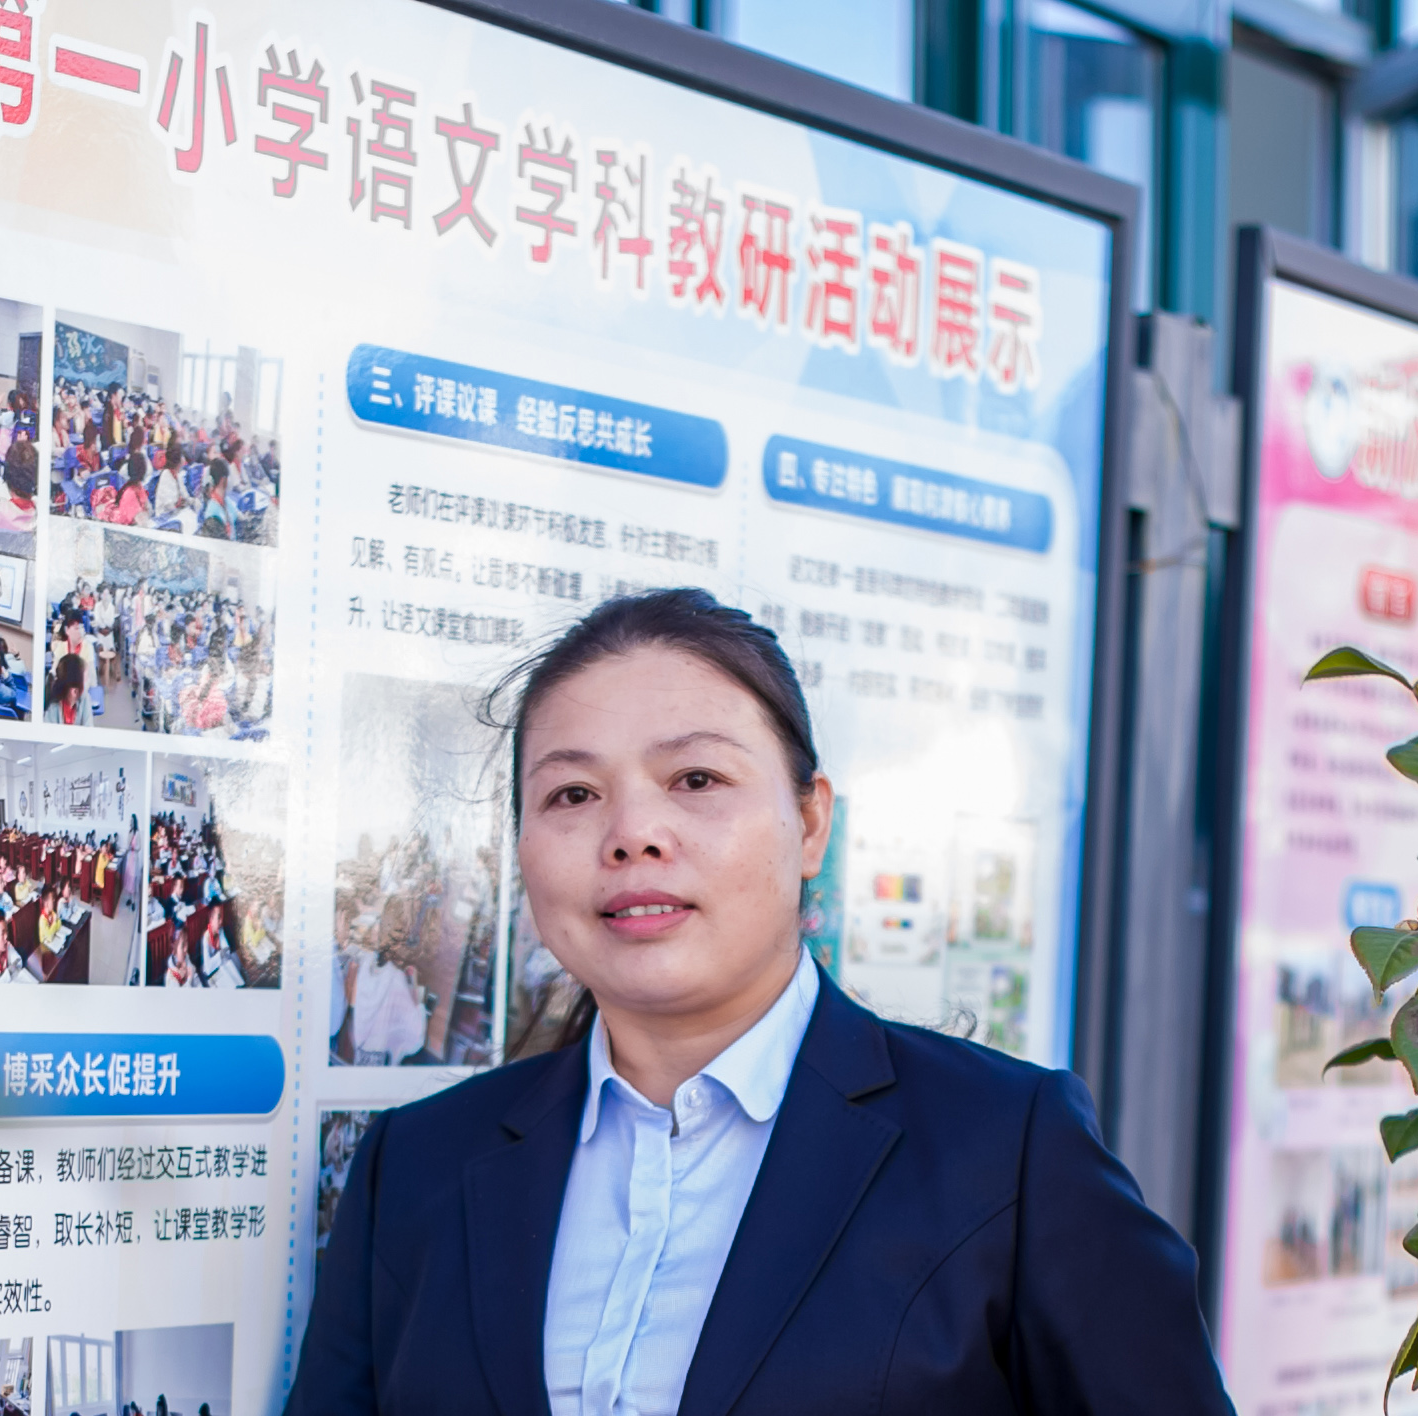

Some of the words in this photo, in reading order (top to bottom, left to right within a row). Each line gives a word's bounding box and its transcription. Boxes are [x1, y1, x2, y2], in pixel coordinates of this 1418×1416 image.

[369, 365, 498, 427] 三、评课议课
[515, 394, 653, 459] 经验反思共成长
[2, 1051, 181, 1098] 博采众长促提升
